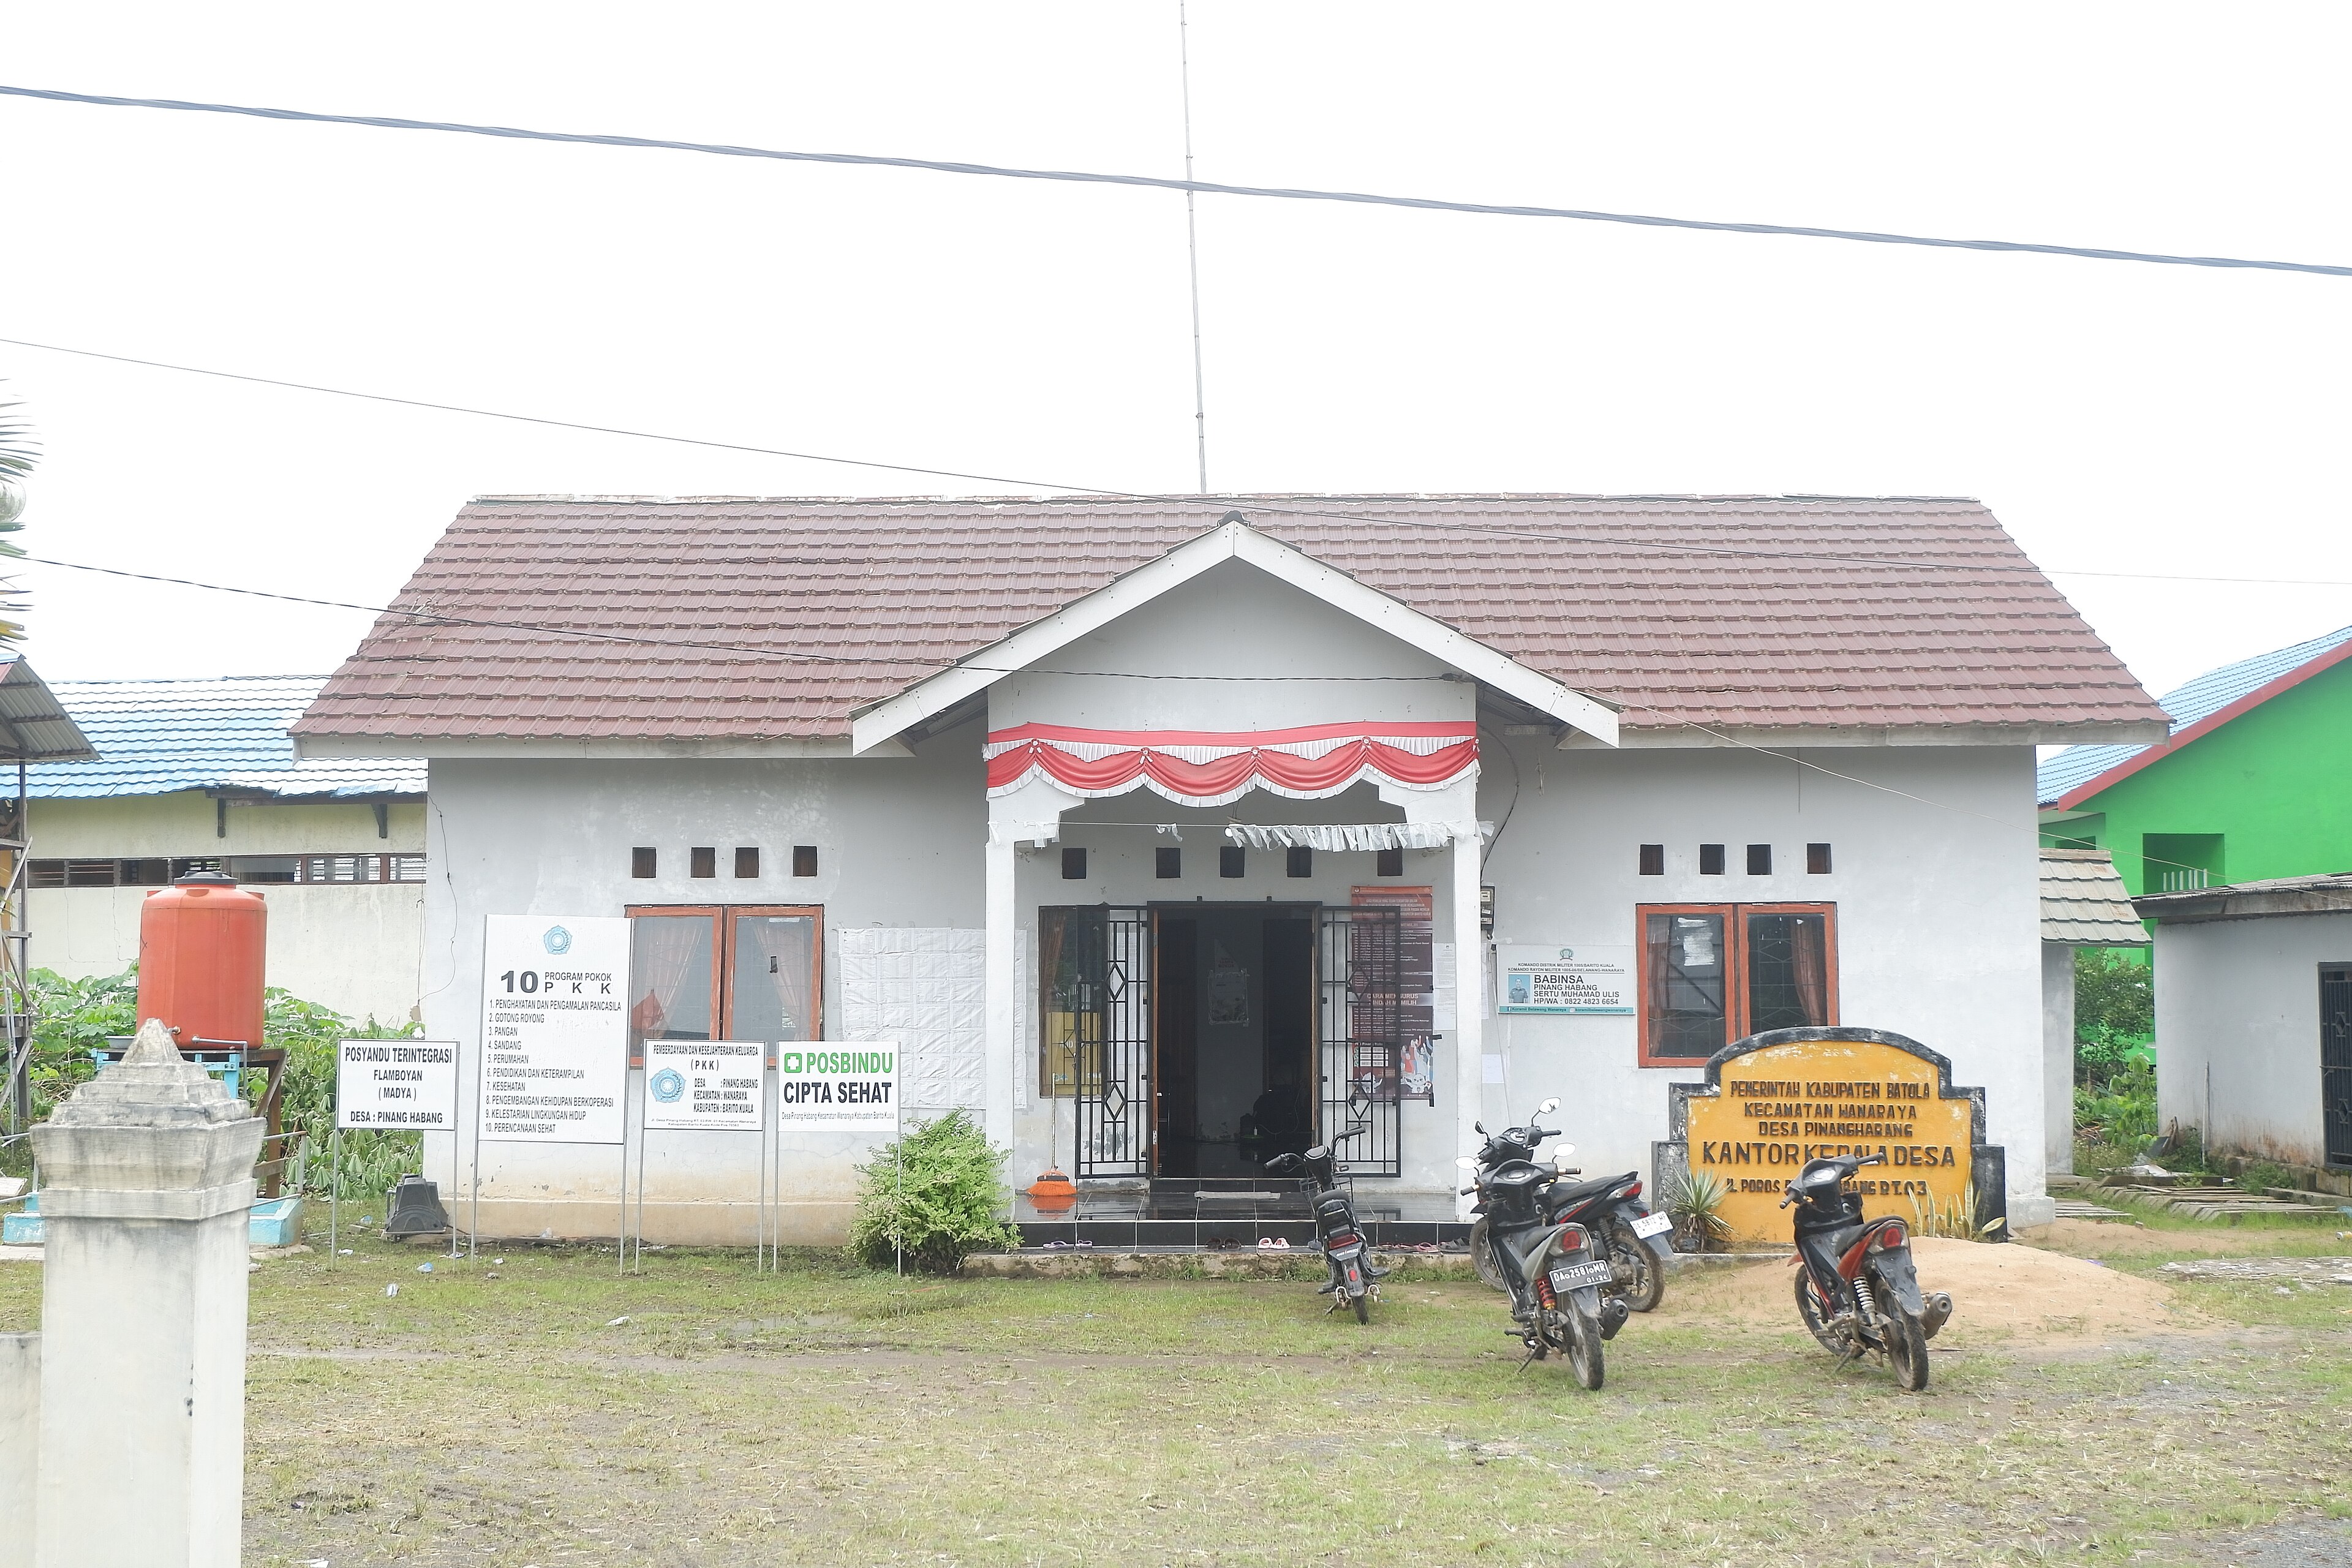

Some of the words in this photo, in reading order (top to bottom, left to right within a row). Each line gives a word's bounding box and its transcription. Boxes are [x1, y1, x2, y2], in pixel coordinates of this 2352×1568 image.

[501, 970, 538, 993] 10
[545, 972, 582, 981] PROGRAM
[585, 973, 612, 981] POKOK
[1534, 974, 1583, 984] BABINSA
[490, 999, 494, 1008] 1.
[496, 999, 535, 1009] PENGHAYATAN
[537, 1000, 548, 1009] DAN
[550, 1000, 589, 1010] PENGAMALAN
[590, 1001, 621, 1011] PANCASILA
[489, 1012, 494, 1022] 2.
[495, 1013, 519, 1022] GOTONG
[521, 1013, 545, 1023] ROYONG
[489, 1027, 493, 1036] 3.
[495, 1027, 518, 1036] PANGAN
[488, 1040, 492, 1049] 4.
[494, 1040, 521, 1050] SANDANG
[654, 1045, 688, 1055] PEMBERDAYAAN
[688, 1046, 698, 1055] DAN
[698, 1046, 734, 1055] KESEJAHTERAAN
[735, 1046, 758, 1056] KELUARGA
[345, 1047, 390, 1062] POSYANDU
[393, 1048, 452, 1063] TERINTEGRASI
[488, 1054, 492, 1063] 5.
[494, 1054, 529, 1064] PERUMAHAN
[807, 1052, 892, 1073] POSBINDU
[374, 1070, 423, 1081] FLAMBOYAN
[487, 1068, 492, 1077] 6.
[493, 1068, 527, 1077] PENDIDIKAN
[528, 1068, 540, 1078] DAN
[541, 1069, 584, 1079] KETERAMPILAN
[487, 1081, 491, 1091] 7.
[492, 1081, 526, 1091] KESEHATAN
[695, 1078, 706, 1088] DESA
[723, 1079, 739, 1088] PINANG
[740, 1079, 758, 1088] HABANG
[784, 1082, 832, 1103] CIPTA
[838, 1082, 892, 1103] SEHAT
[1730, 1080, 1800, 1098] PEMERINTAH
[1806, 1081, 1880, 1098] KABUPATEN
[1887, 1082, 1930, 1099] BATOLA
[486, 1095, 491, 1104] 8.
[492, 1095, 540, 1105] PENGEMBANGAN
[541, 1096, 573, 1106] KEHIDUPAN
[574, 1097, 614, 1107] BERKOPERASI
[694, 1090, 720, 1100] KECAMATAN
[723, 1091, 747, 1101] WANARAYA
[693, 1103, 720, 1113] KABUPATEN
[723, 1104, 739, 1113] BARITO
[739, 1104, 753, 1114] KUALA
[1744, 1101, 1833, 1118] KECAMATAN
[1839, 1103, 1917, 1119] WANARAYA
[350, 1111, 371, 1122] DESA
[377, 1112, 407, 1123] PINANG
[410, 1112, 443, 1123] HABANG
[486, 1109, 490, 1118] 9.
[491, 1109, 529, 1119] KELESTARIAN
[531, 1110, 568, 1120] LINGKUNGAN
[569, 1110, 586, 1120] HIDUP
[791, 1112, 803, 1121] Pinang
[804, 1112, 817, 1121] Habang
[837, 1112, 854, 1121] Wanaraya
[854, 1111, 873, 1121] Kabupaten
[494, 1123, 537, 1133] PERENCANAAN
[538, 1123, 556, 1133] SEHAT
[1758, 1121, 1799, 1136] DESA
[1702, 1141, 1800, 1164] KANTOR
[1894, 1145, 1955, 1167] DESA
[1741, 1179, 1780, 1193] POROS
